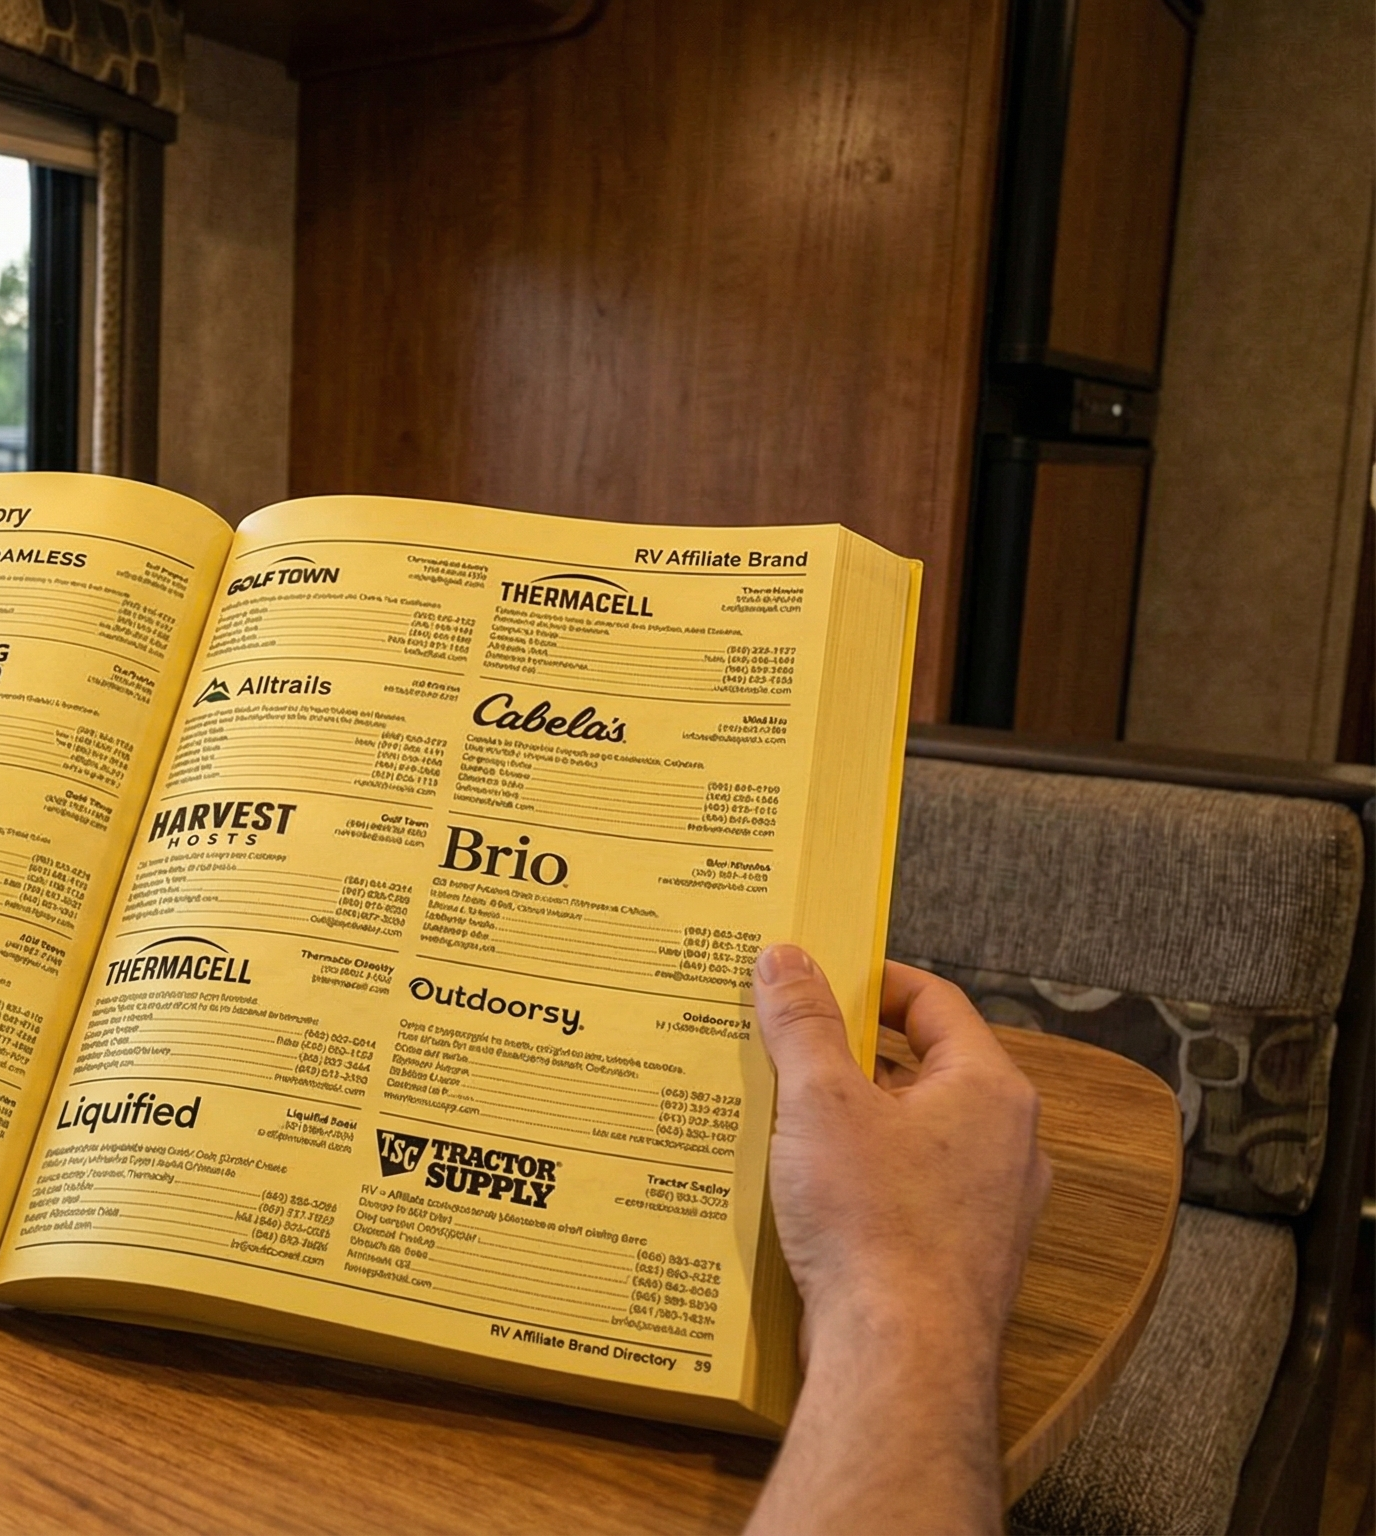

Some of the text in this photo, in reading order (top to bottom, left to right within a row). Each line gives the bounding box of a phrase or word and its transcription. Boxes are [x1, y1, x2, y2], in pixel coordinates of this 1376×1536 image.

[634, 548, 808, 567] RV Affiliate Brand
[227, 567, 340, 596] GOLF TOWN
[500, 581, 654, 617] THERMACELL
[237, 675, 332, 696] Alltrails
[473, 692, 627, 744] Cabela's
[148, 801, 297, 843] HARVEST
[167, 832, 258, 849] HOSTS
[437, 825, 568, 886] Brio
[105, 955, 252, 986] THERMACELL
[56, 1092, 202, 1133] Liquified
[380, 1131, 419, 1172] TSC
[430, 1139, 558, 1182] TRACTOR
[424, 1162, 556, 1209] SUPPLY
[490, 1323, 511, 1339] RV
[512, 1328, 565, 1349] Affiliate
[568, 1338, 610, 1357] Brand
[612, 1346, 678, 1371] Directory
